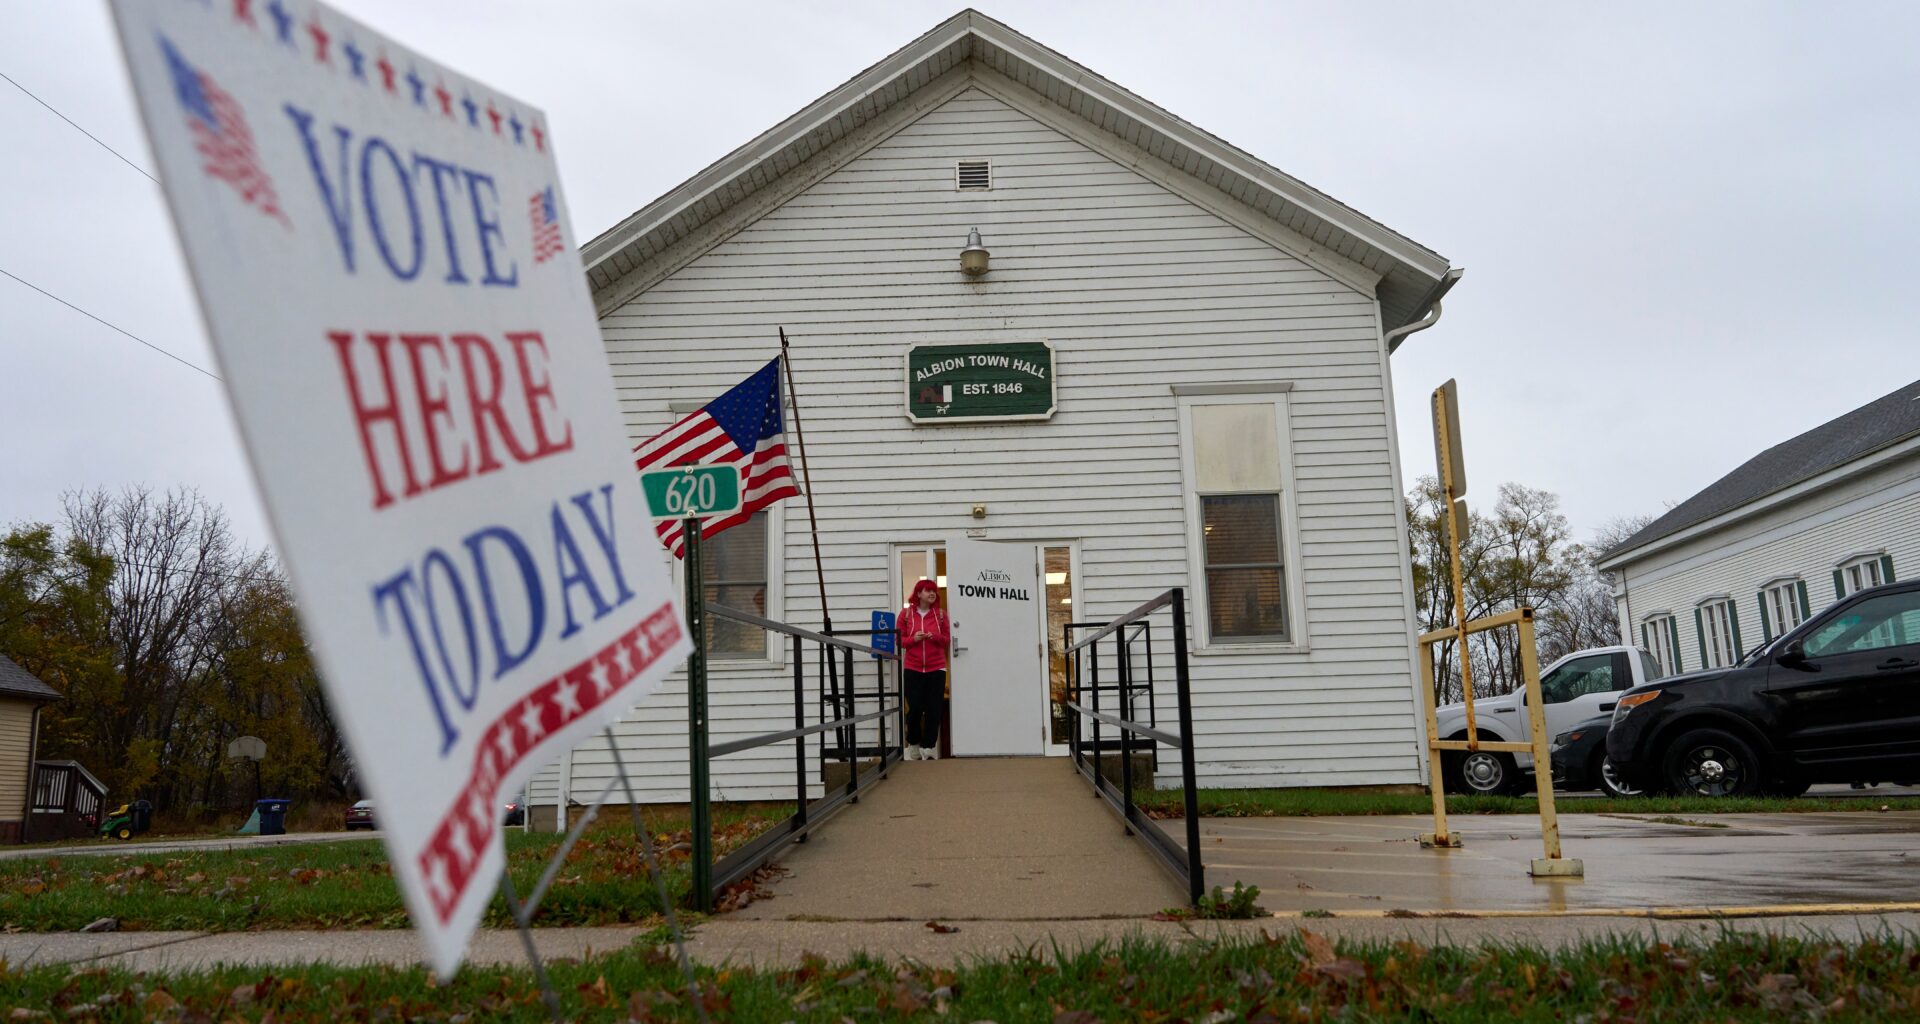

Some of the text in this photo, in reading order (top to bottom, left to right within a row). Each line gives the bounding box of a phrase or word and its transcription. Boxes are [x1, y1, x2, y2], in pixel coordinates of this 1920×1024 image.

[282, 102, 520, 290] VOTE
[916, 355, 1045, 381] ALBION TOWN HALL
[963, 382, 1023, 395] EST. 1846
[326, 330, 575, 511] HERE
[665, 473, 717, 513] 620
[958, 584, 1030, 601] TOWN HALL
[371, 483, 638, 758] TODAY
